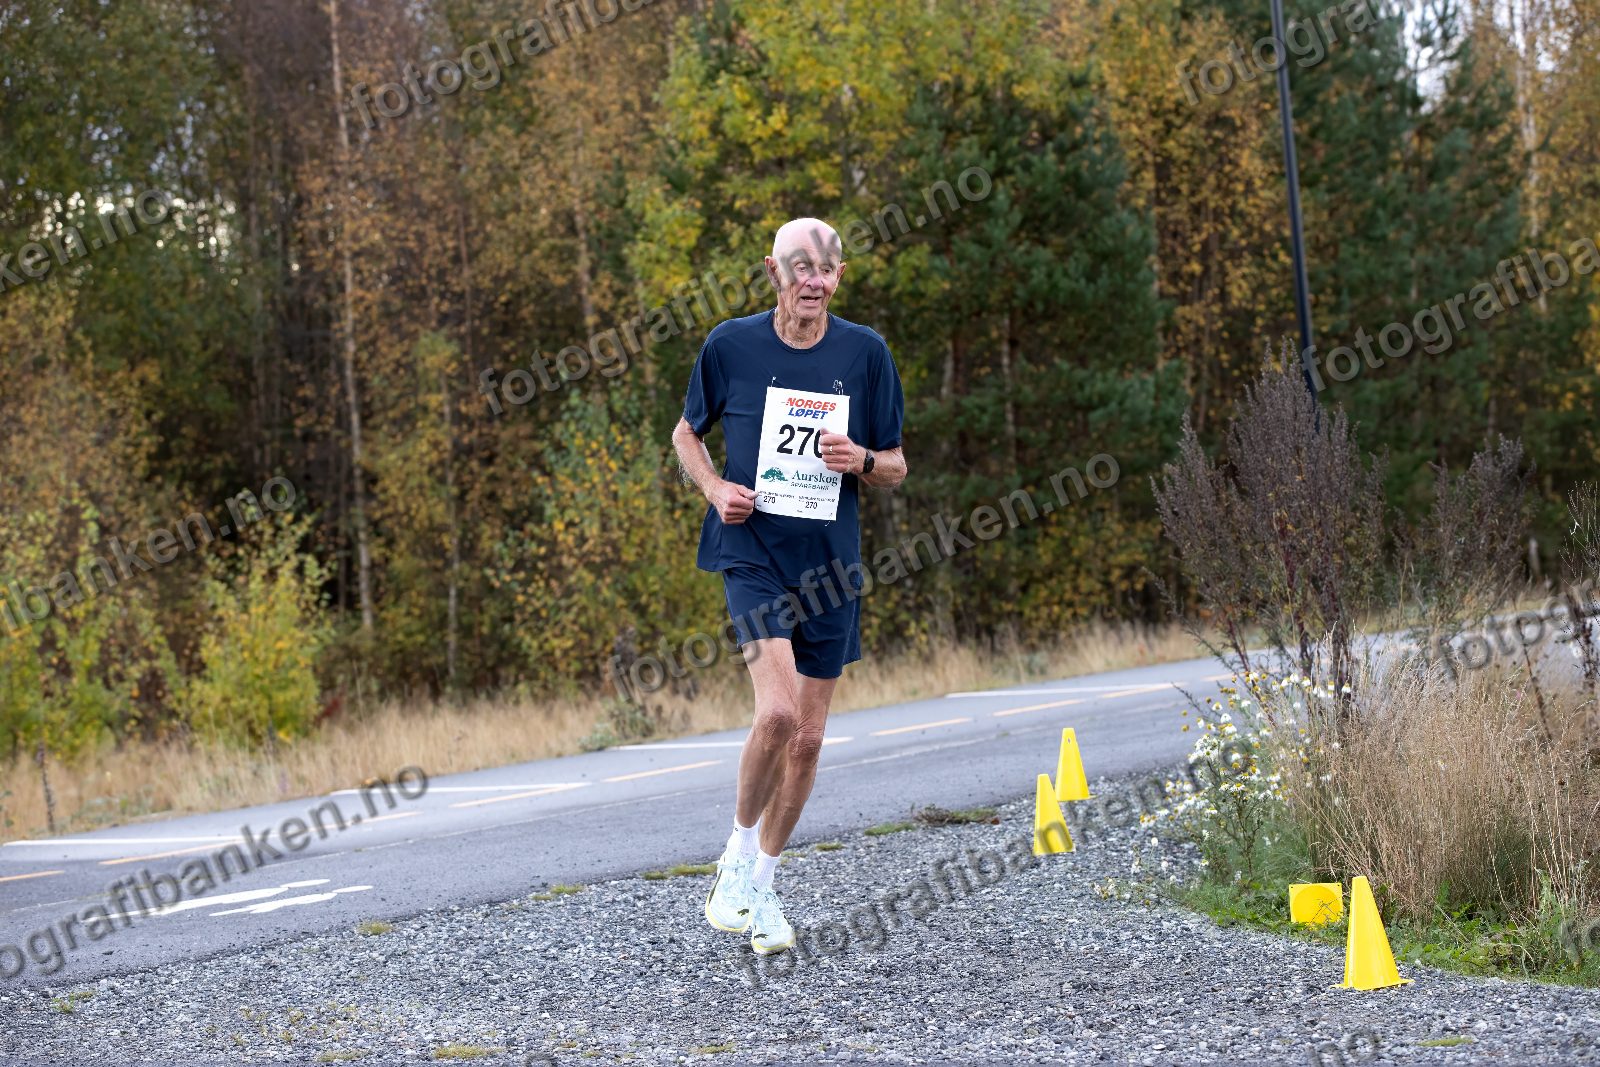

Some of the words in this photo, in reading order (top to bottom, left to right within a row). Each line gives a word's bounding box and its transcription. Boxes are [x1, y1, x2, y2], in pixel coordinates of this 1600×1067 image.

[785, 397, 837, 411] NORGES
[788, 407, 828, 420] LØPET
[791, 470, 838, 487] Aurskog
[763, 495, 776, 504] 270
[805, 501, 818, 509] 270
